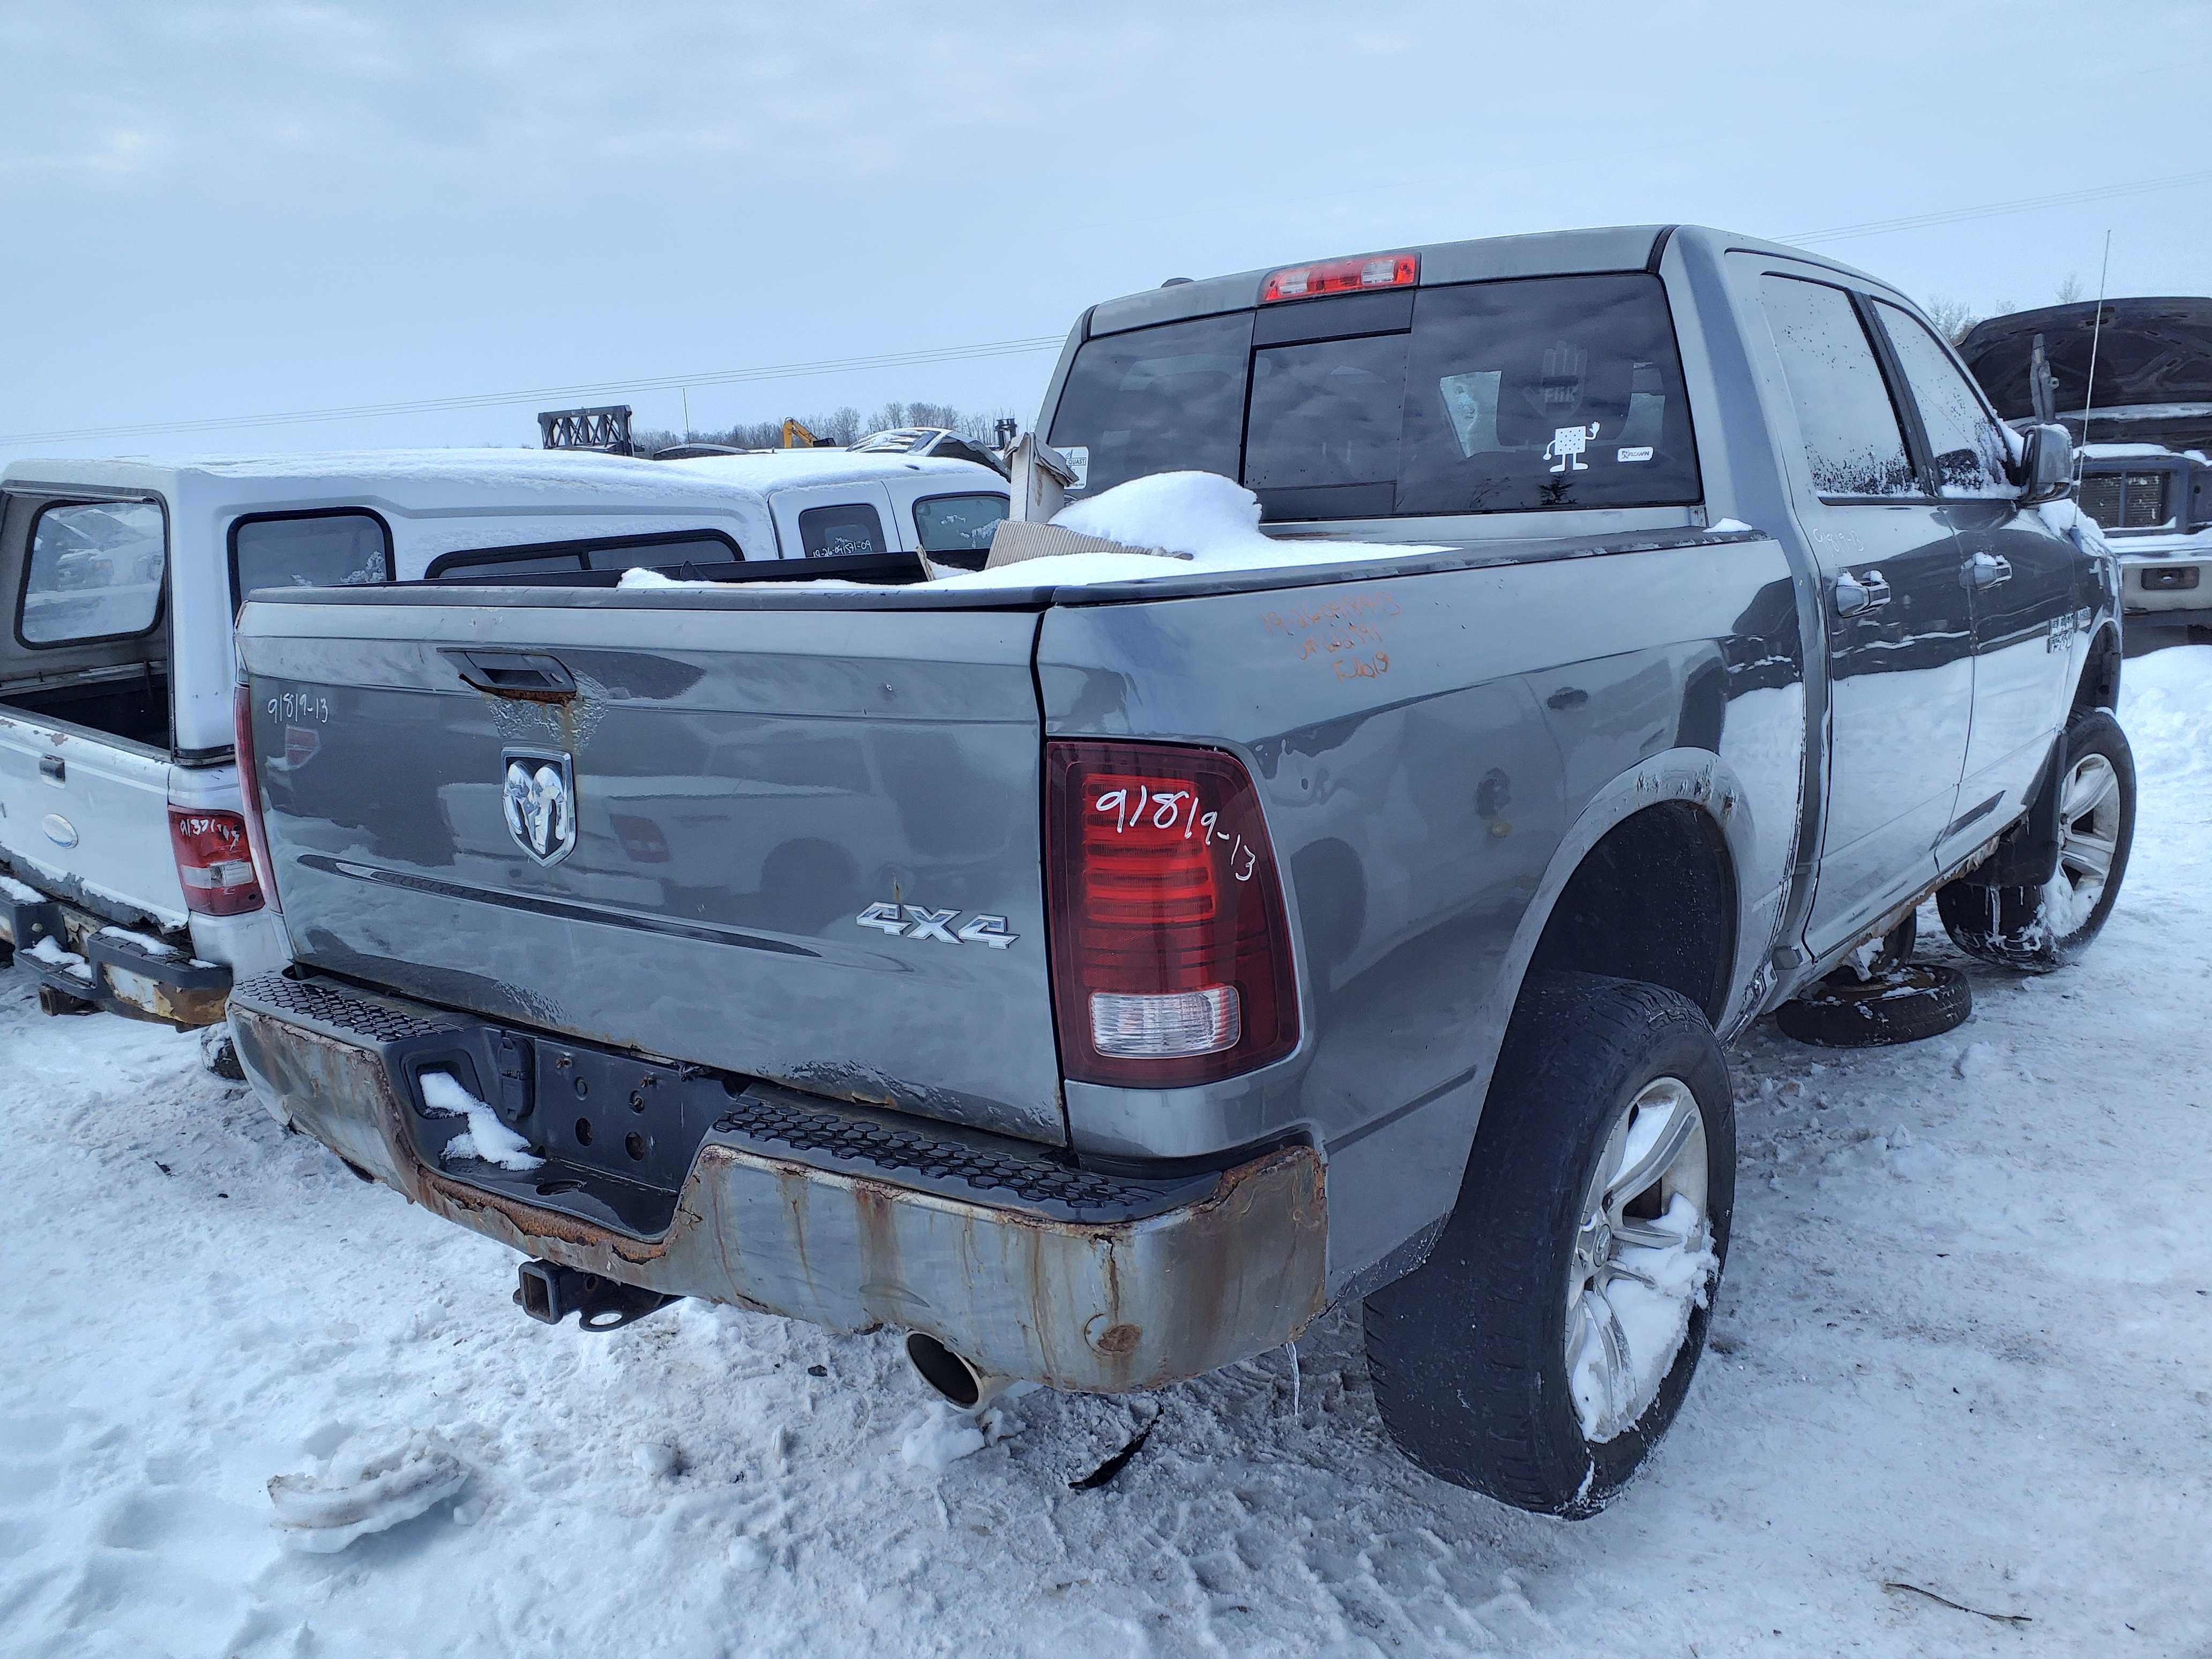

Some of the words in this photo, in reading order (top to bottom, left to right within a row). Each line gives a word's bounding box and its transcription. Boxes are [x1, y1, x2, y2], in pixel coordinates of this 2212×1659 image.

[1621, 450, 1650, 459] KROWN
[268, 692, 328, 723] 91819-13
[1096, 784, 1256, 881] 91819-13
